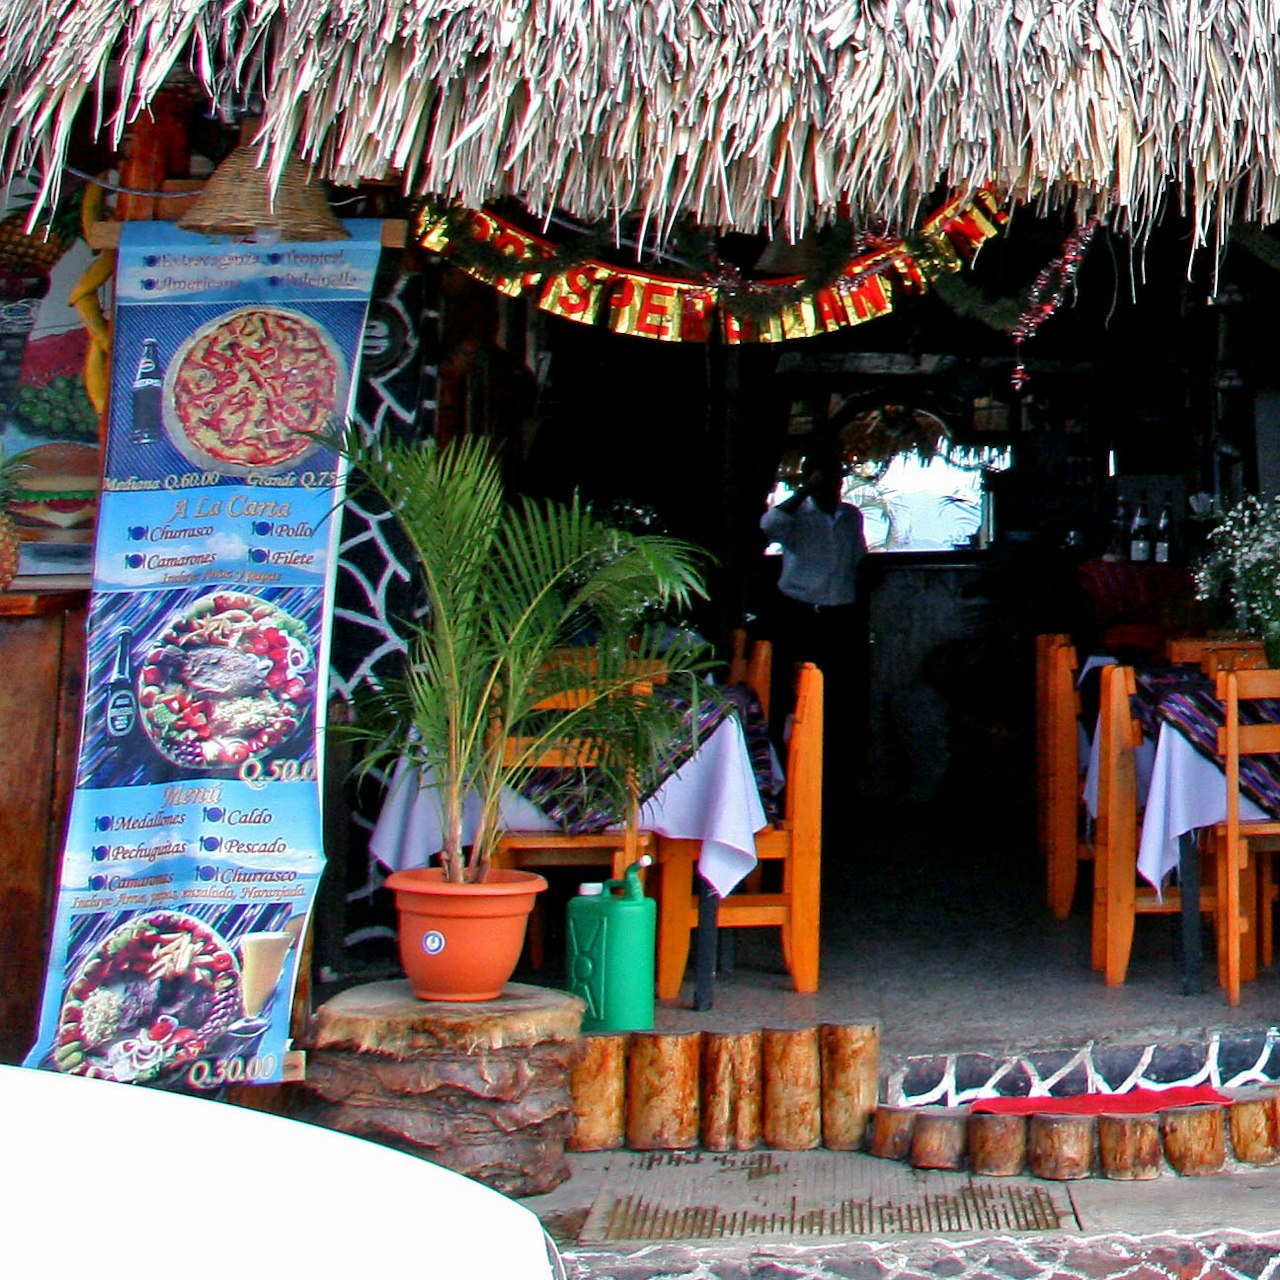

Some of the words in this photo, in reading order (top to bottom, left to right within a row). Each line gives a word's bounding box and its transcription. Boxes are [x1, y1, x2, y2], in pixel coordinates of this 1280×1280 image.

[165, 471, 220, 492] Q.60.00
[193, 497, 221, 519] La
[225, 495, 292, 519] Carta
[150, 525, 214, 542] Churrasco
[275, 522, 312, 538] Pollo
[147, 552, 218, 570] Camarones
[271, 551, 315, 565] Filete
[162, 783, 223, 808] Menú
[115, 811, 187, 831] Medallones
[227, 807, 272, 826] Caldo
[225, 836, 287, 854] Pescado
[220, 866, 297, 884] Churrasco
[188, 1053, 278, 1089] Q.30.00
